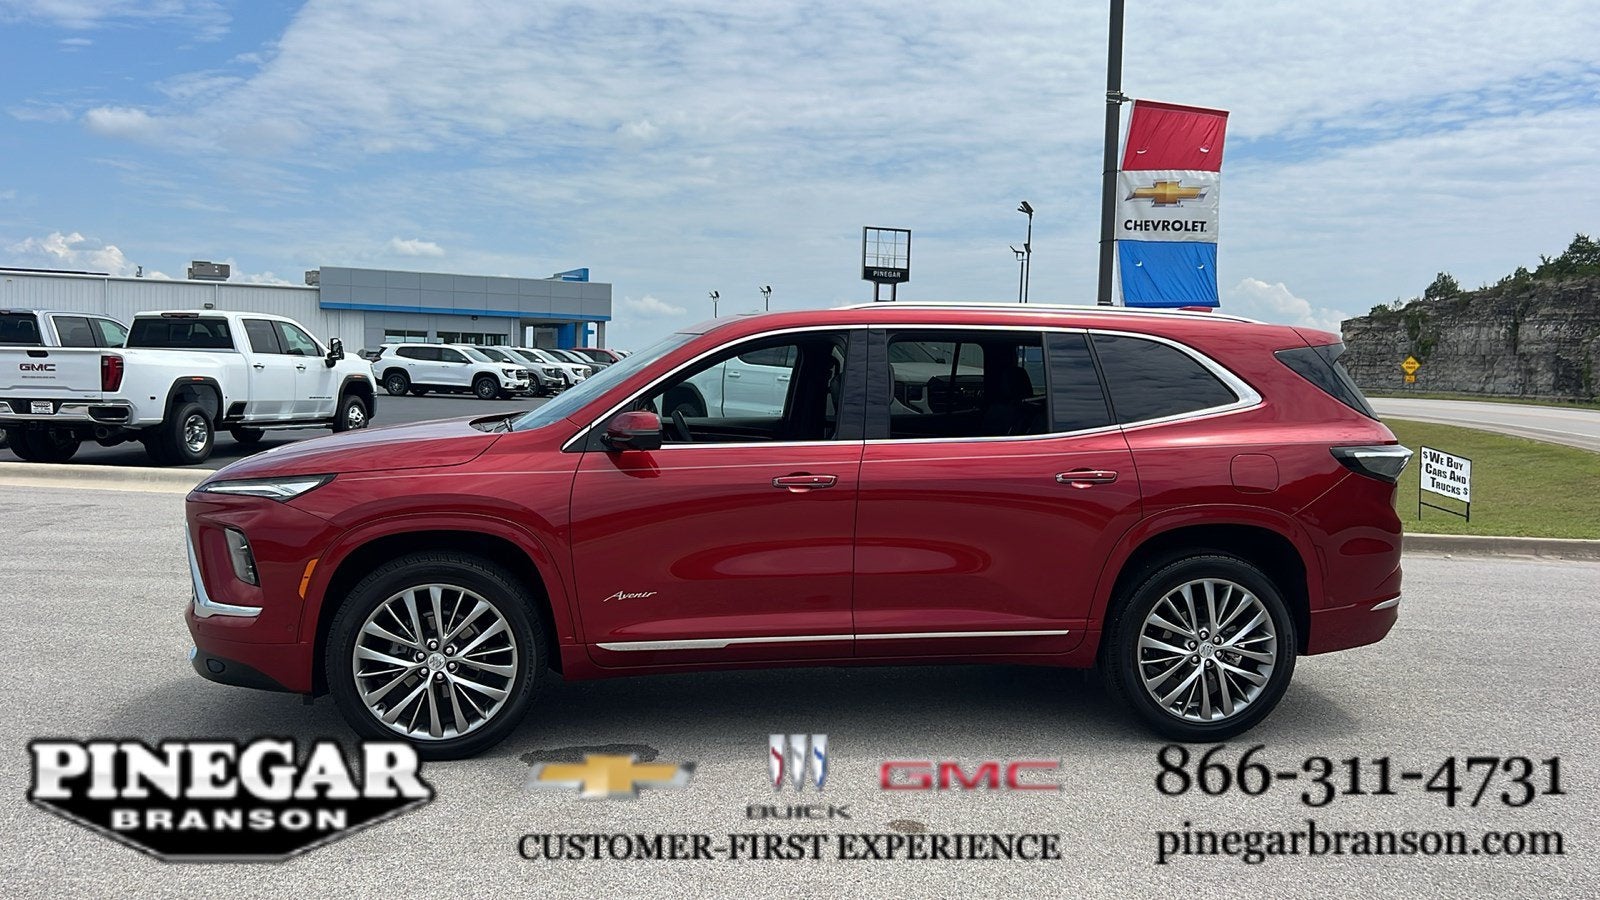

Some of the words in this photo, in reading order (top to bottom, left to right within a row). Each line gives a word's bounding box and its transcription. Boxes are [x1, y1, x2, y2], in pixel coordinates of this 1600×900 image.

[1124, 219, 1207, 232] CHEVROLET
[873, 270, 901, 278] PINEGAR
[19, 363, 57, 372] GMC
[603, 590, 657, 602] Avenir
